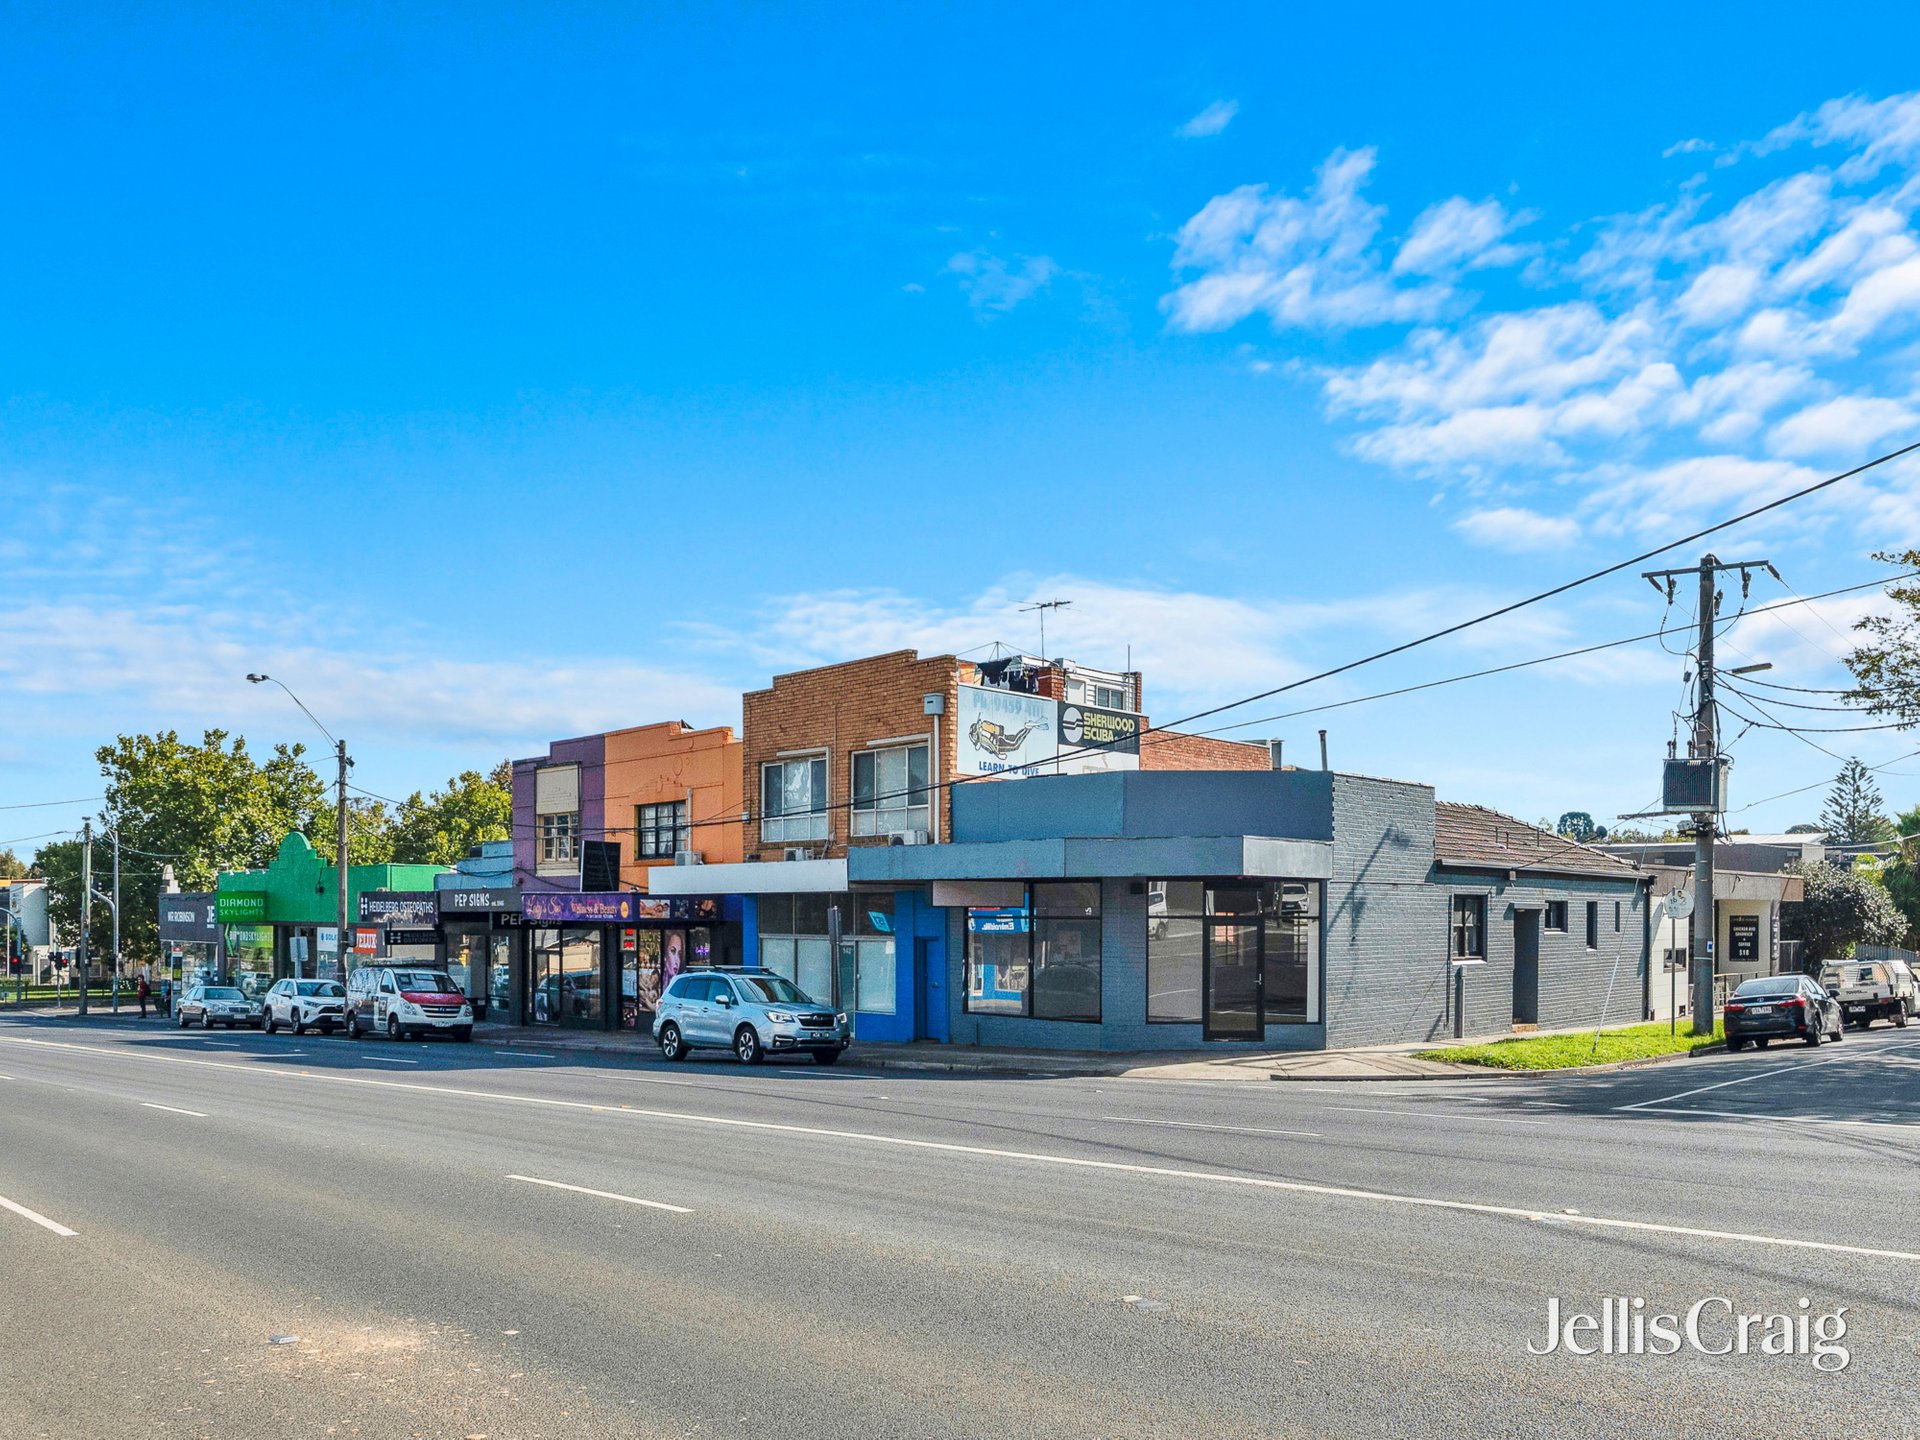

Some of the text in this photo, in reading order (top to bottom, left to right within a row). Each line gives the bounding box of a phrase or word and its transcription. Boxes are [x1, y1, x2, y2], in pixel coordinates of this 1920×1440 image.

[1083, 712, 1136, 733] SHERWOOD
[1083, 727, 1114, 743] SCUBA
[979, 761, 1004, 773] LEARN
[1008, 764, 1020, 775] TO
[219, 898, 264, 908] DIAMOND
[454, 894, 467, 907] PEP
[468, 893, 490, 907] SIGNS
[219, 908, 264, 916] SKYLIGHTS
[369, 901, 434, 914] HEIDELBERG OSTEOPATHS
